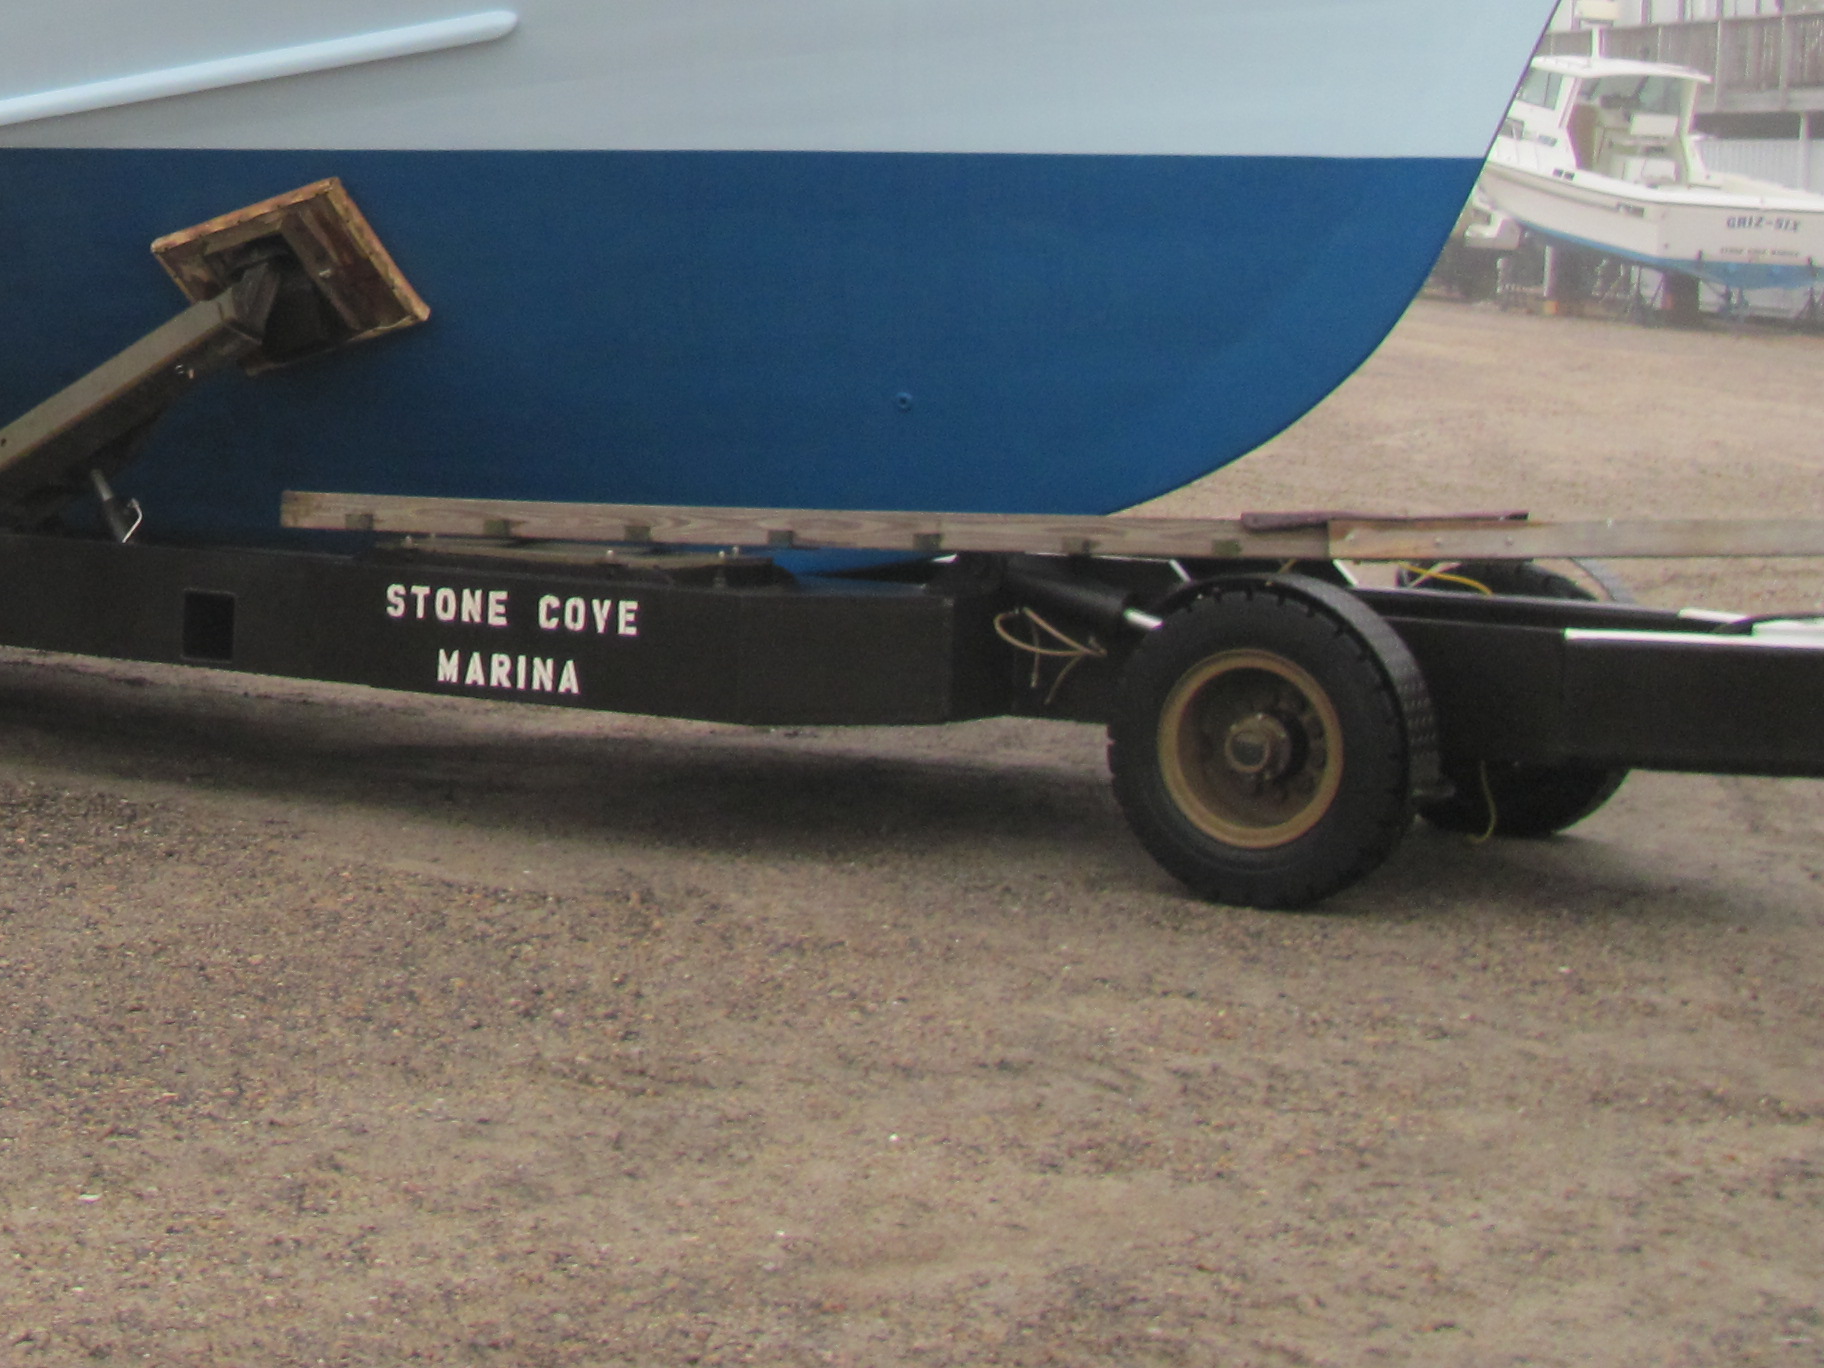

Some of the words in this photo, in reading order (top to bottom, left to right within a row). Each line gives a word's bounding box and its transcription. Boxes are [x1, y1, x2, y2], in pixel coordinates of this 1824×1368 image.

[385, 583, 509, 627] STONE
[537, 594, 639, 636] COVE
[437, 648, 580, 695] MARINA
